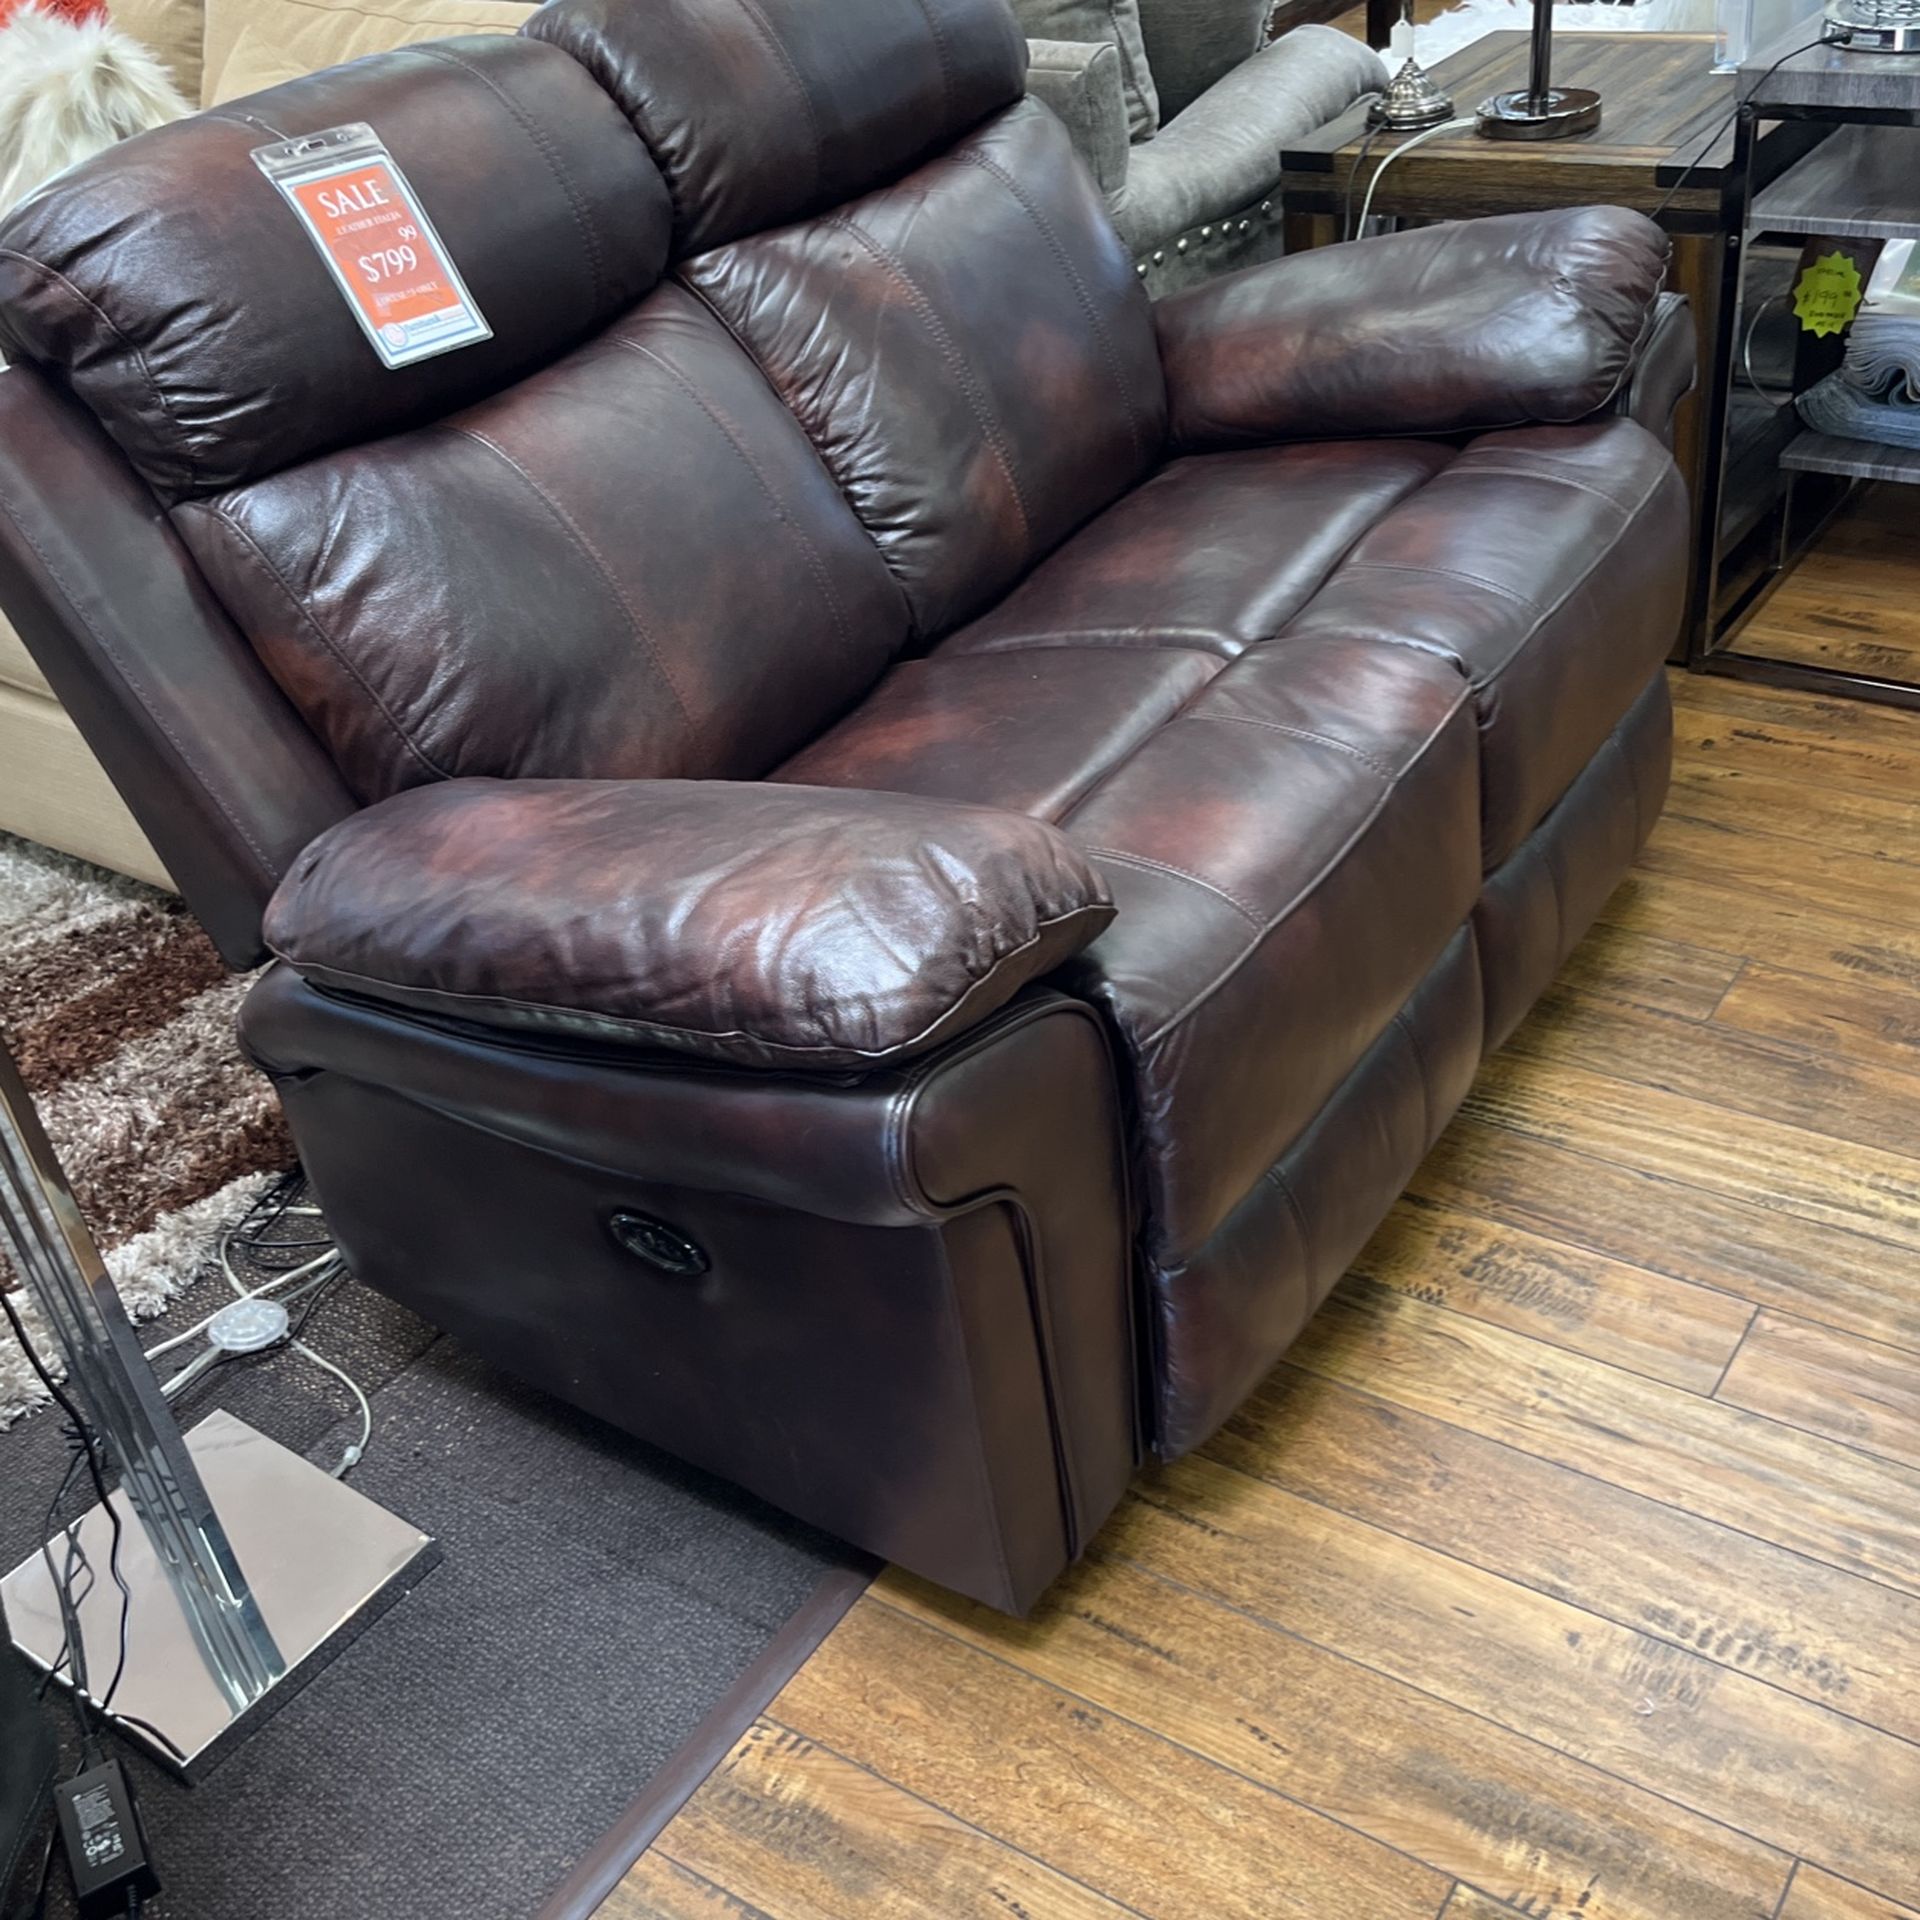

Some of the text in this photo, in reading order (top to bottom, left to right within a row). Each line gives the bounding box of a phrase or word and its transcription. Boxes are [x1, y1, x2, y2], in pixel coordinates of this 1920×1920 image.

[318, 180, 389, 218] SALE
[359, 225, 417, 283] $799 99
